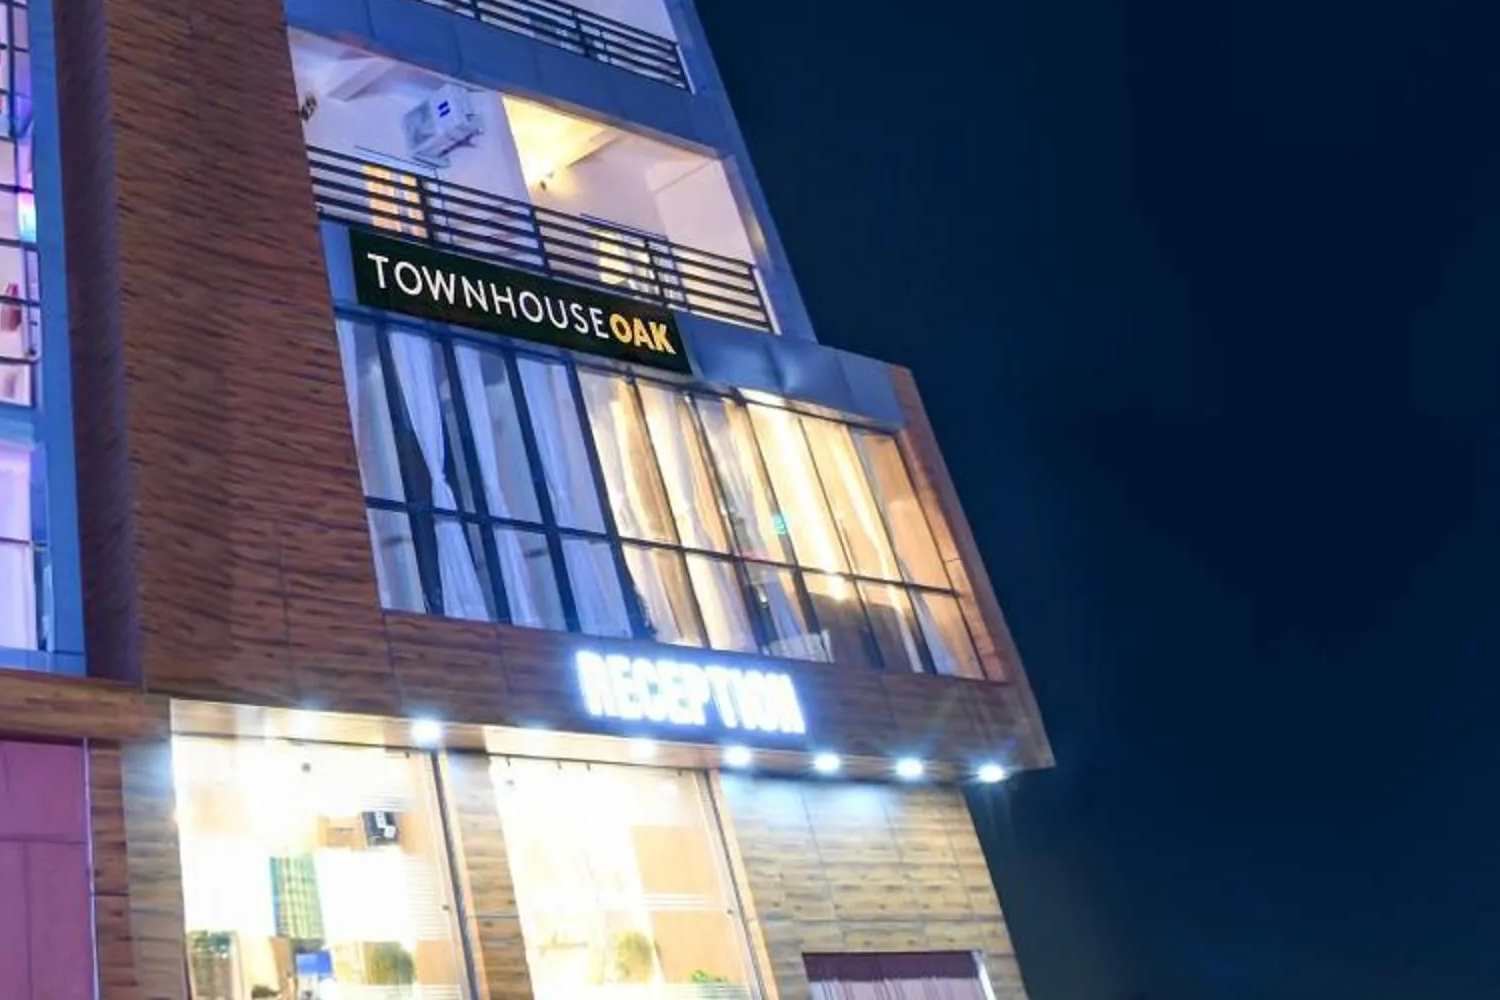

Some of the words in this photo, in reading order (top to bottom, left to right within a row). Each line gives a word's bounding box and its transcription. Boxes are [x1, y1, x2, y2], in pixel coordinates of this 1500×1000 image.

[367, 252, 610, 340] TOWNHOUSE
[608, 312, 677, 355] OAK
[575, 650, 806, 734] RECEPTION
